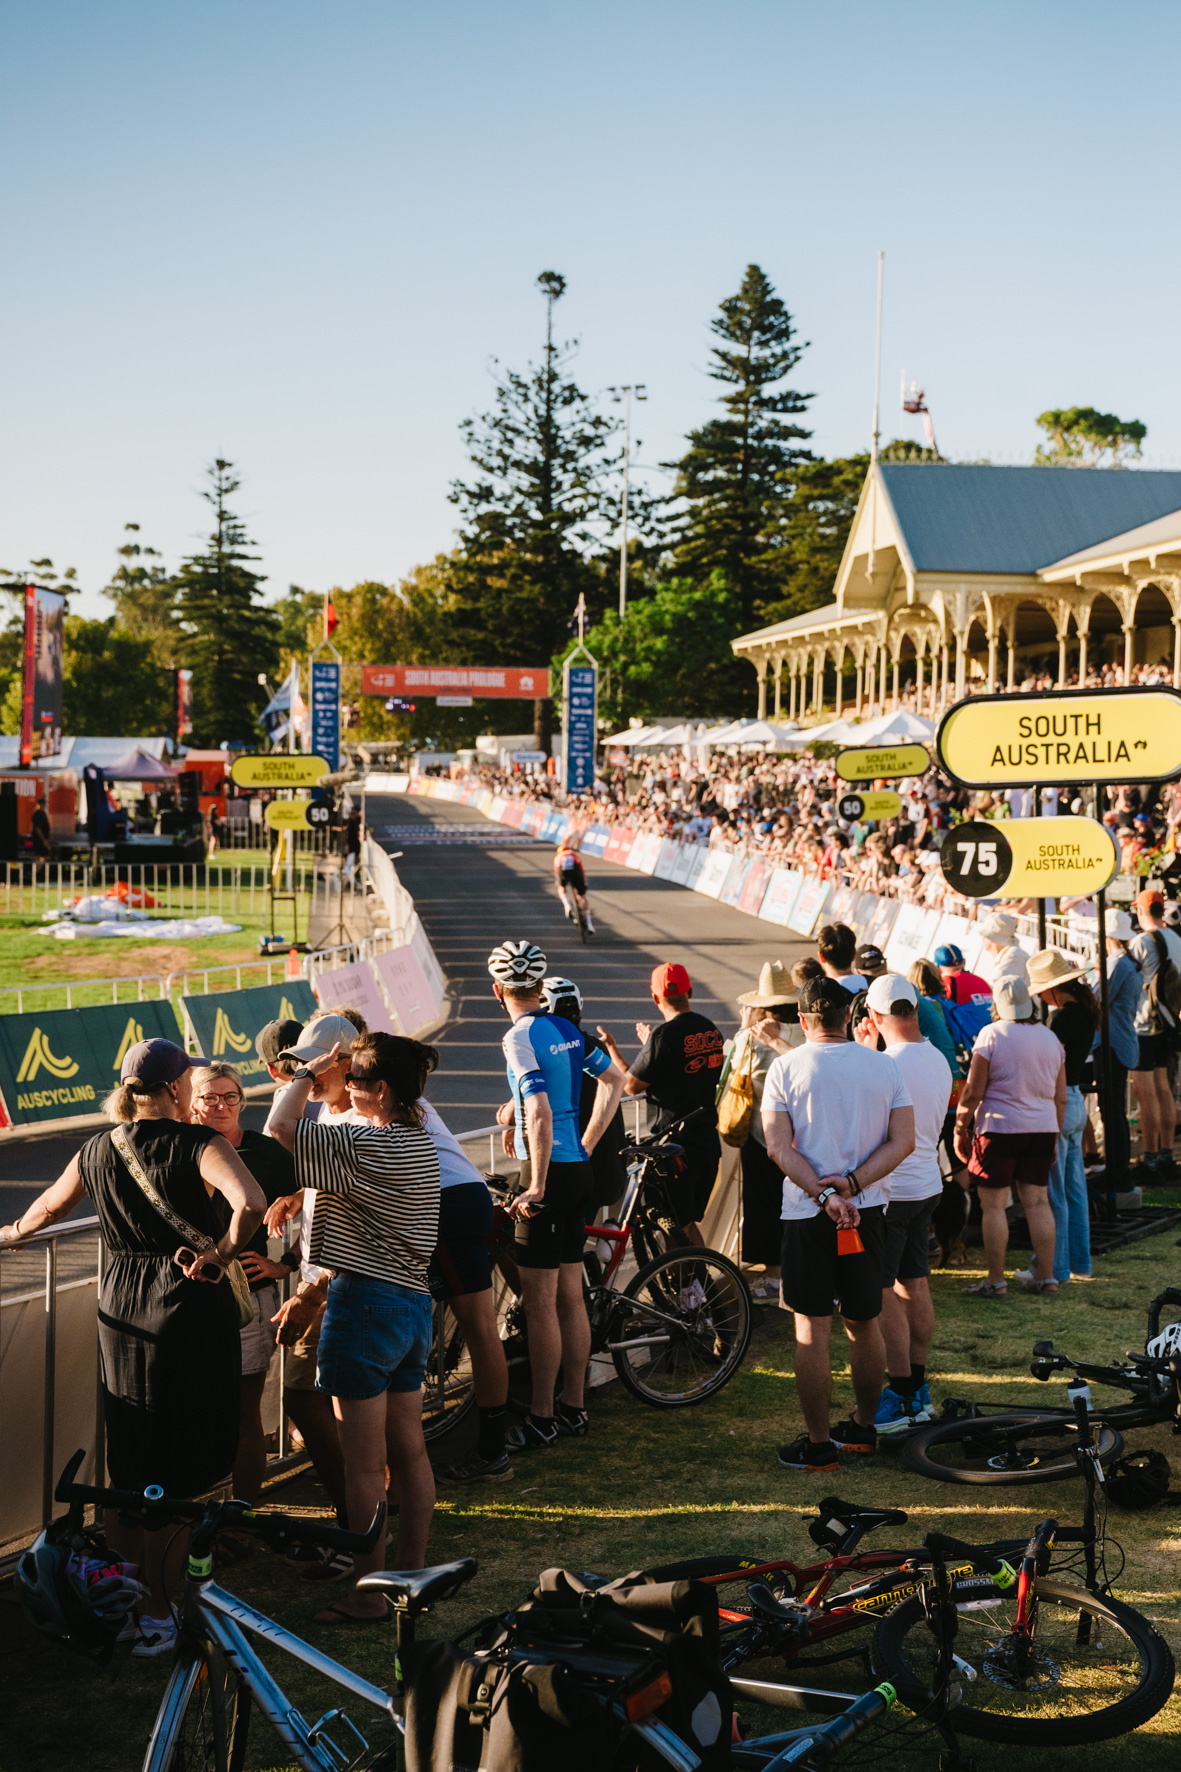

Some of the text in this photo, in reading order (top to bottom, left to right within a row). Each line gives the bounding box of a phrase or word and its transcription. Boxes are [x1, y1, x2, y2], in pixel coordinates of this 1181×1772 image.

[1018, 713, 1102, 738] SOUTH
[865, 752, 897, 764] SOUTH
[990, 740, 1131, 767] AUSTRALIA
[262, 761, 295, 771] SOUTH
[856, 763, 908, 775] AUSTRALIA
[252, 772, 306, 781] AUSTRALIA
[311, 807, 329, 822] 50
[843, 801, 860, 815] 50
[1038, 844, 1081, 857] SOUTH
[956, 842, 998, 876] 75
[1025, 857, 1095, 871] AUSTRALIA
[558, 1039, 581, 1052] GIANT
[17, 1084, 96, 1111] AUSCYCLING
